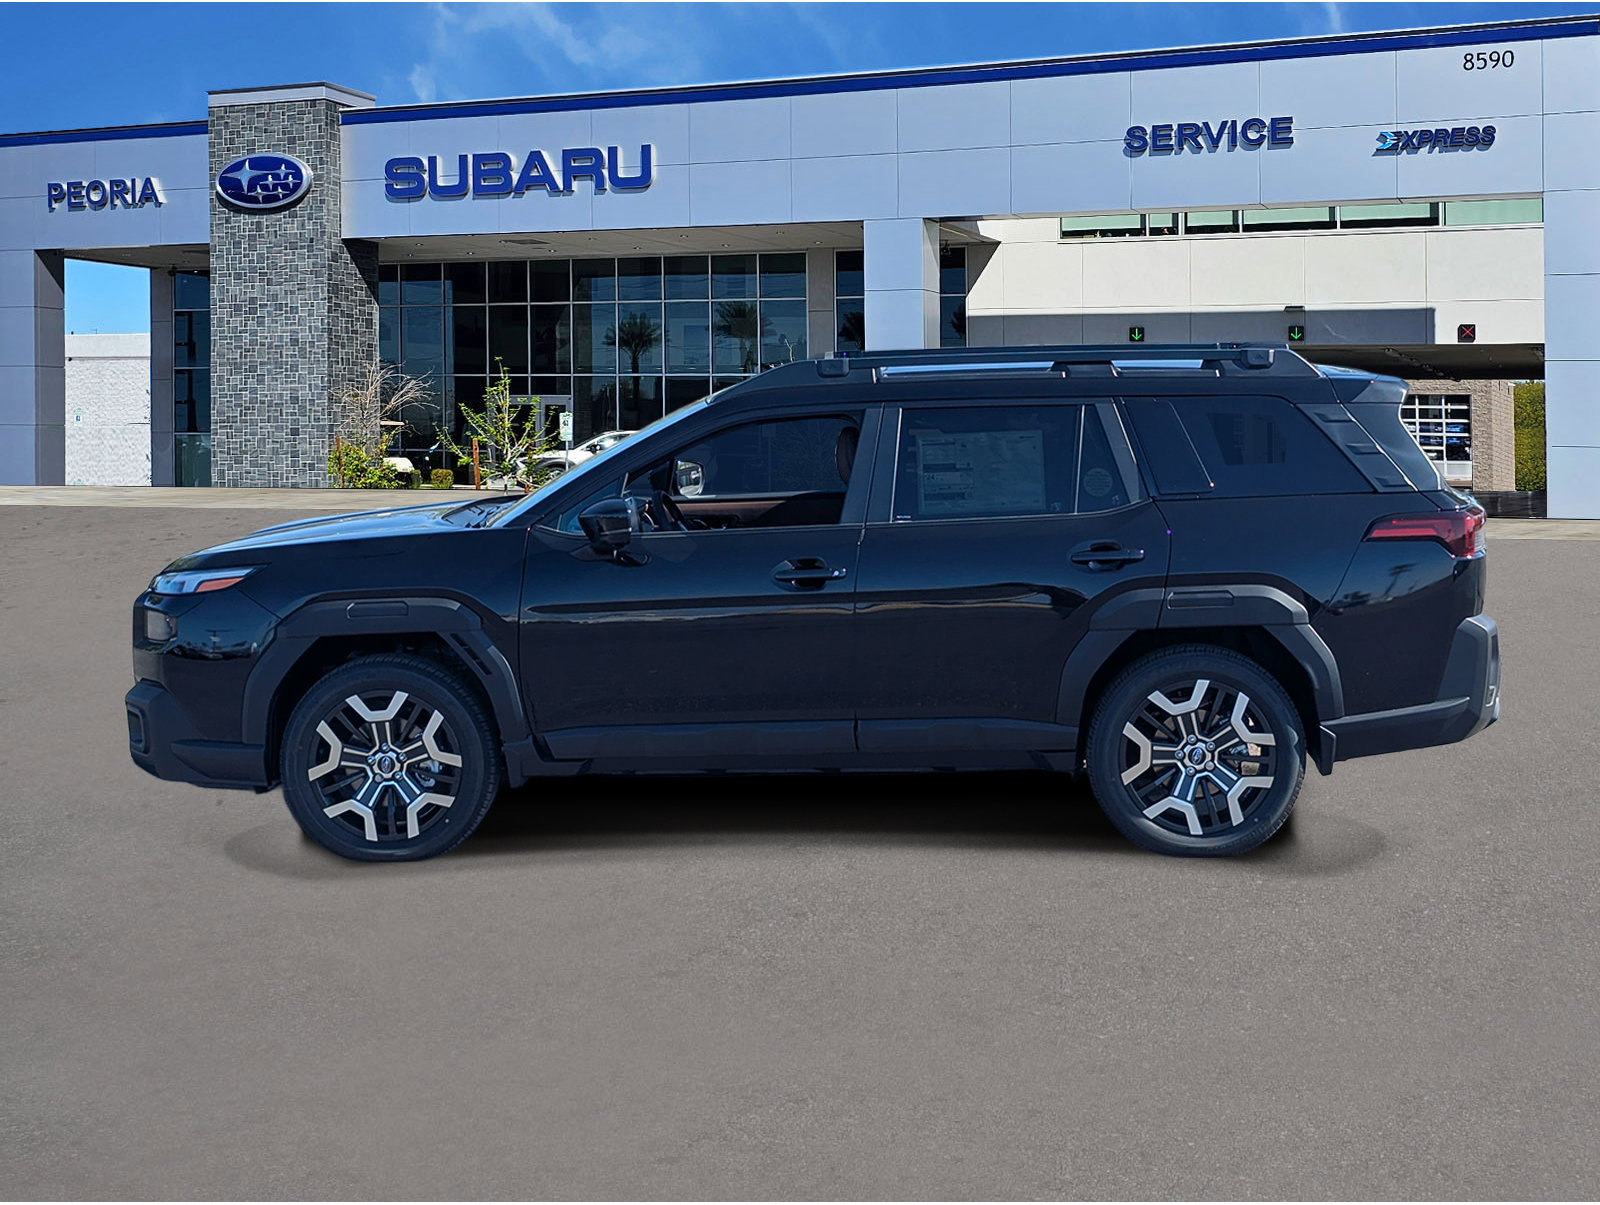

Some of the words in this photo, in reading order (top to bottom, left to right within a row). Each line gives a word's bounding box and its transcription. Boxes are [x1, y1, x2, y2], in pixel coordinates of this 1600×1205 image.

[1463, 50, 1514, 71] 8590
[1125, 116, 1294, 152] SERVICE
[1376, 125, 1497, 151] EXPRESS
[384, 144, 651, 199] SUBARU
[47, 177, 163, 210] PEORIA
